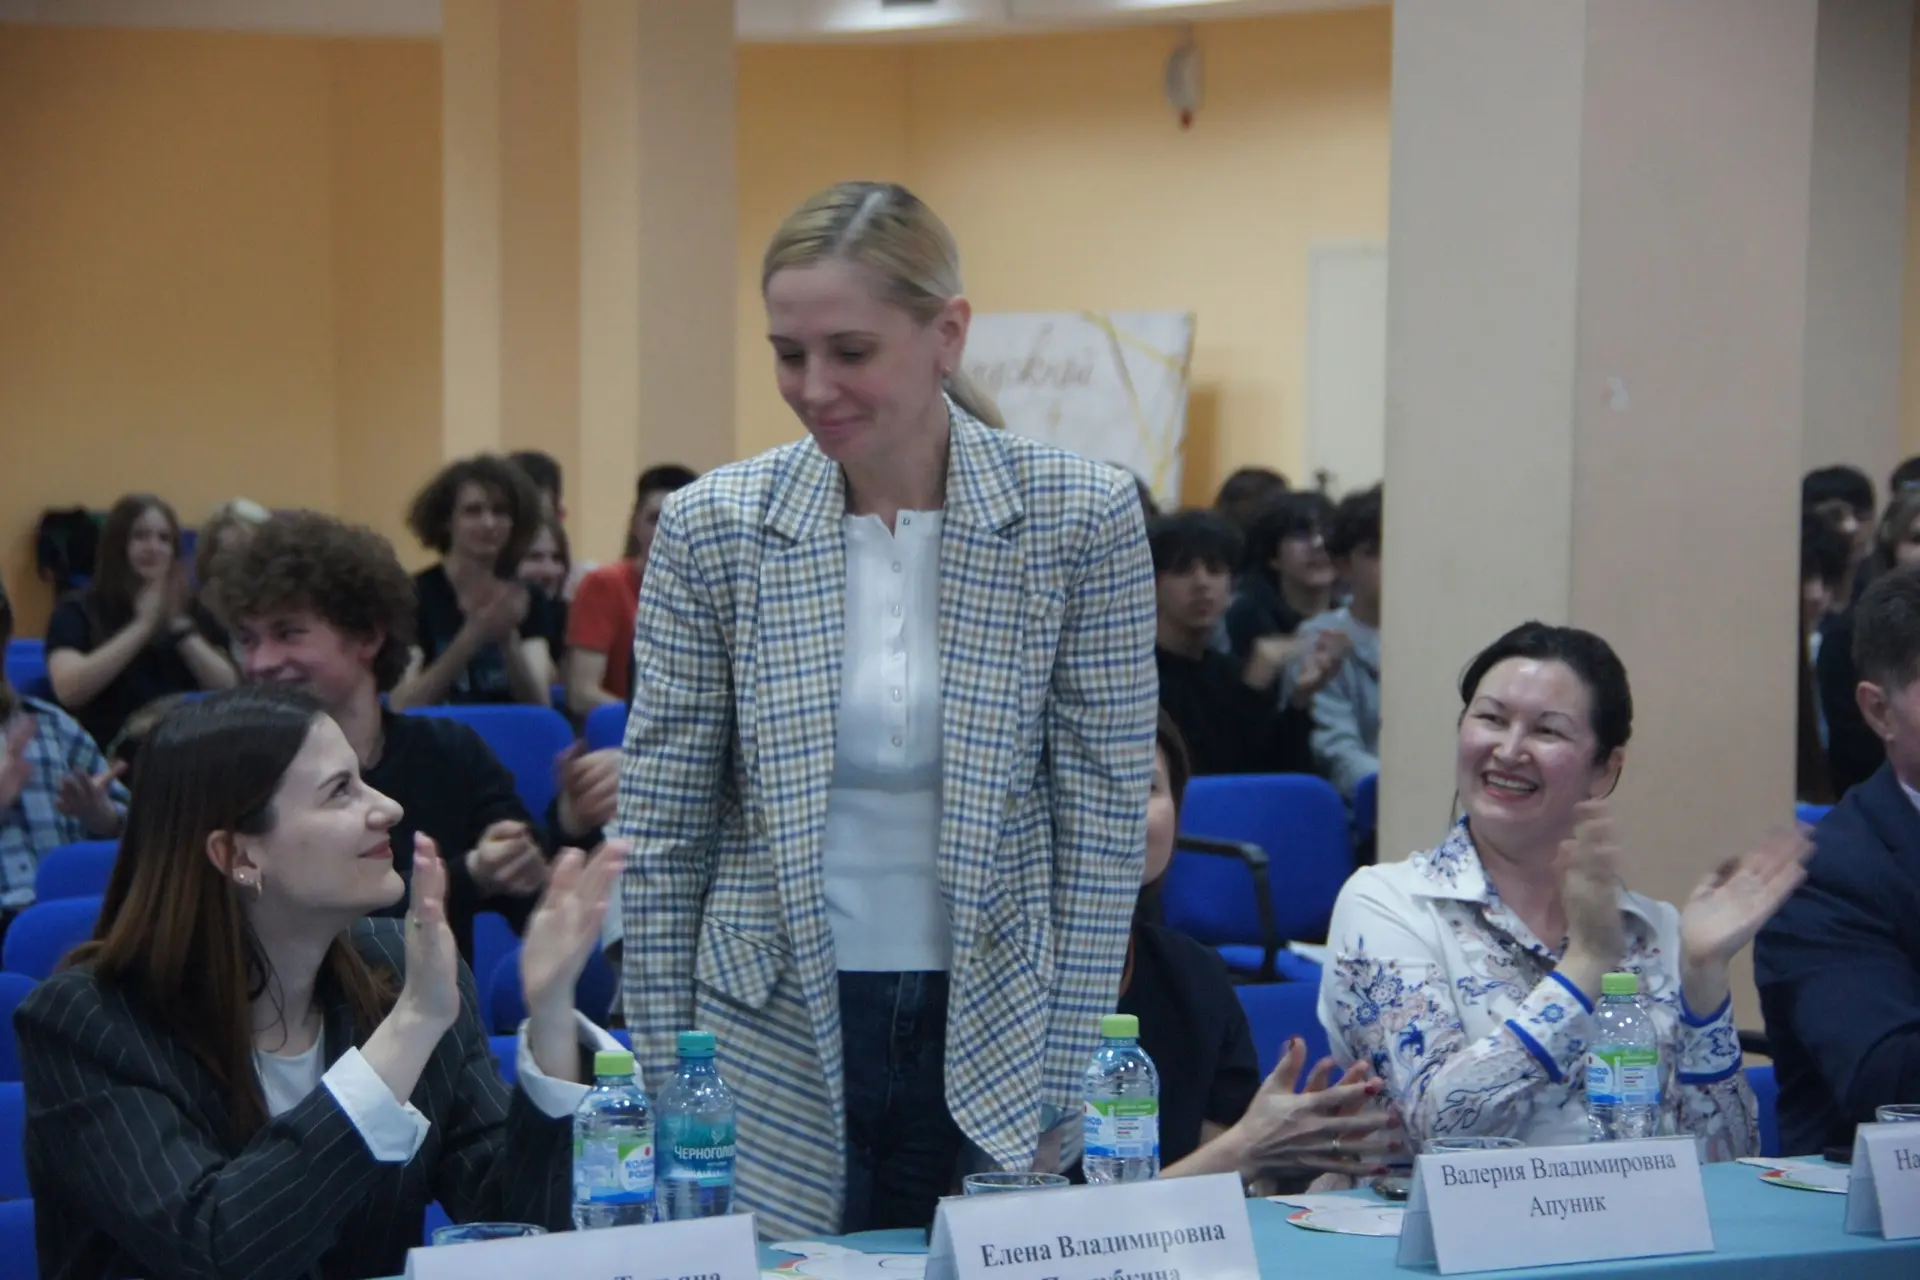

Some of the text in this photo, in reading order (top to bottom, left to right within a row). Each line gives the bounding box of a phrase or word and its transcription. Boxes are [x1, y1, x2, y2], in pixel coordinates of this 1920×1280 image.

[1441, 1152, 1677, 1188] Валерия Владимировна
[1530, 1195, 1607, 1220] Апуник
[980, 1223, 1226, 1268] Елена Владимировна
